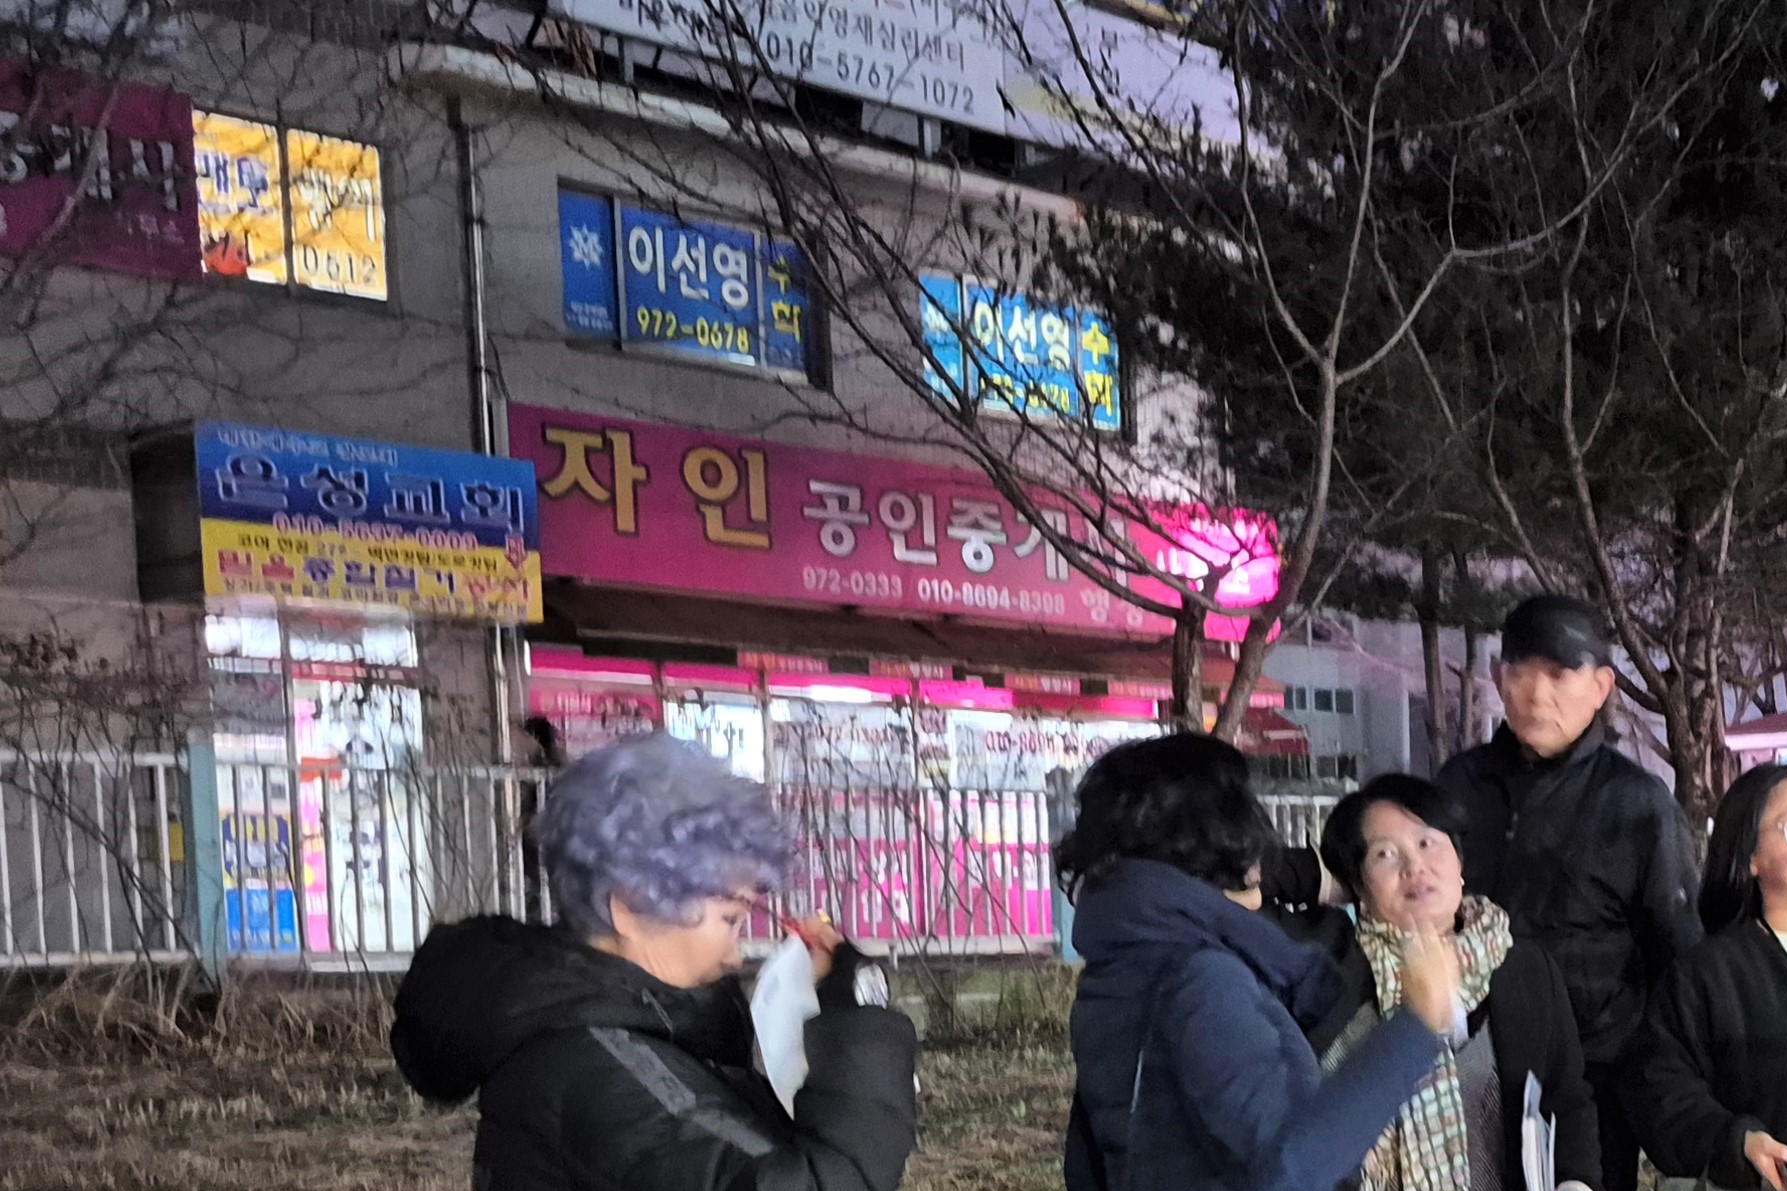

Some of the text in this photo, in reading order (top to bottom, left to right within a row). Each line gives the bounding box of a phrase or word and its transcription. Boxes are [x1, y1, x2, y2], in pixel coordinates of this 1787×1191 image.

[628, 226, 750, 308] 이선영
[637, 305, 750, 354] 972-0678
[974, 301, 1071, 373] 이선영
